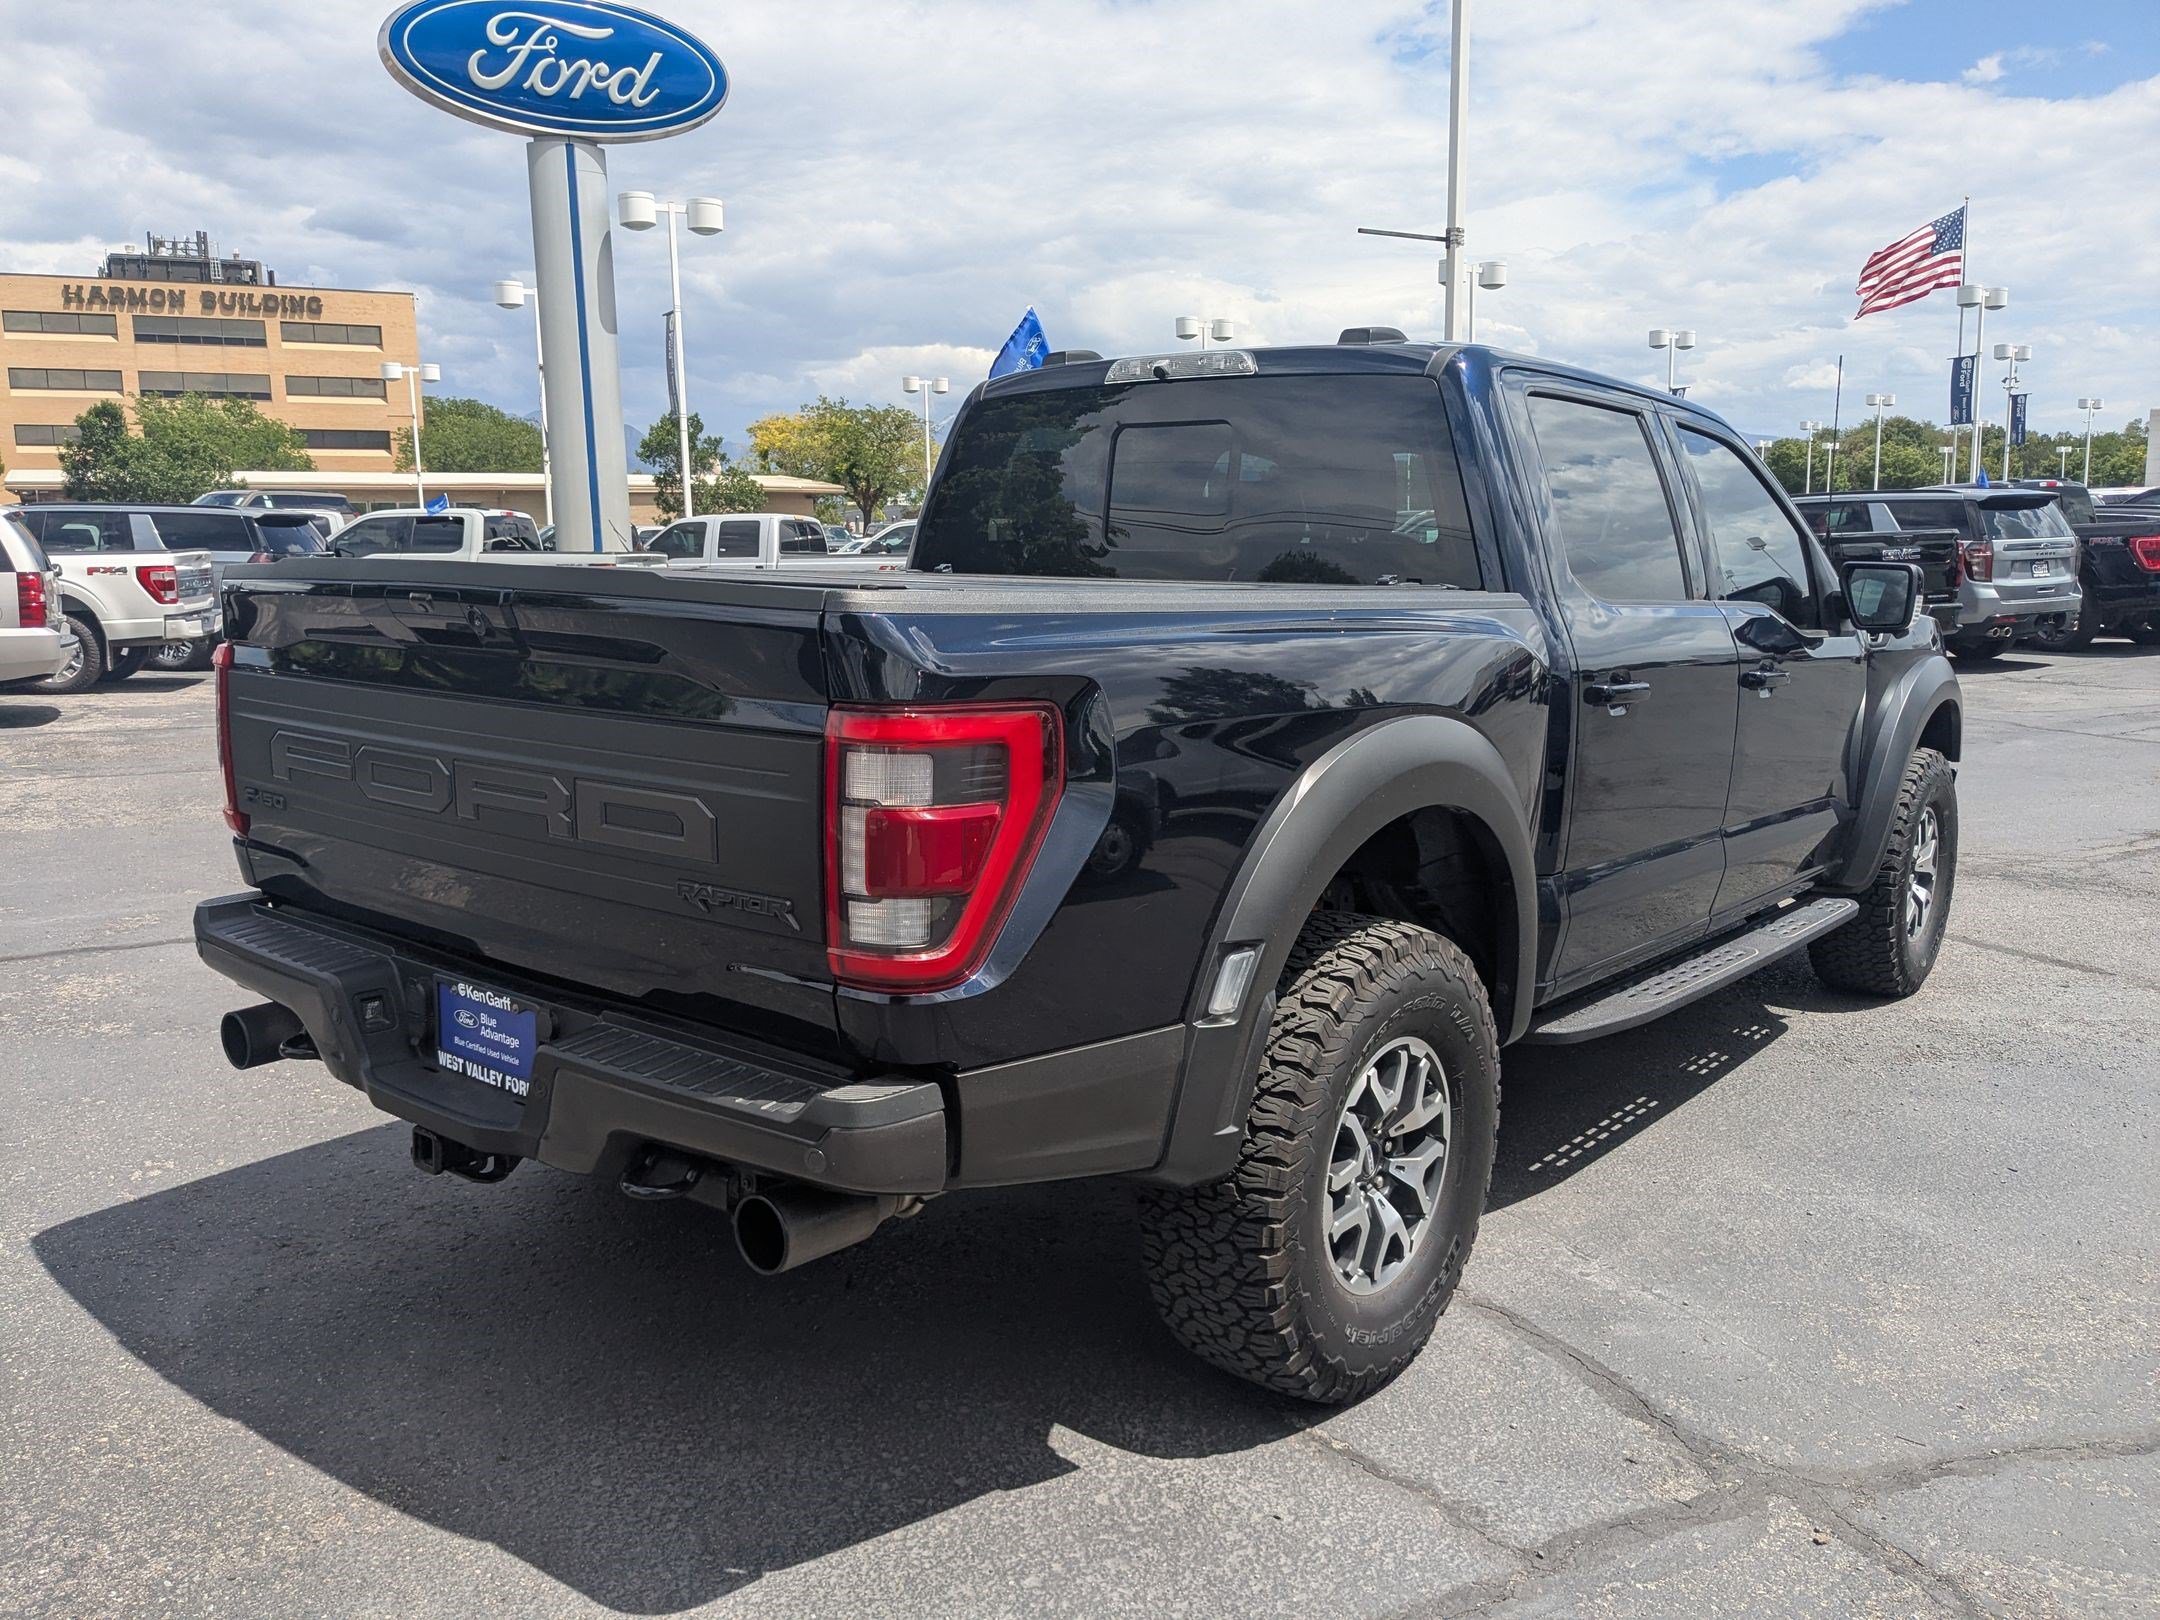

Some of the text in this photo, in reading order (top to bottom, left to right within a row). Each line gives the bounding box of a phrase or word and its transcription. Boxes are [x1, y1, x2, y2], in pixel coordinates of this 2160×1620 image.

[467, 11, 663, 108] Ford
[62, 284, 324, 315] HARMON BUILDING
[1882, 548, 1921, 560] GMC
[87, 567, 128, 576] FX4
[270, 729, 719, 863] FORD
[676, 879, 801, 931] RAPTOR
[480, 1013, 497, 1028] Blue
[454, 1036, 519, 1066] Blue Certified Used Vehicle
[480, 1026, 520, 1049] Advantage
[438, 1050, 530, 1097] WEST VALLEY FOR
